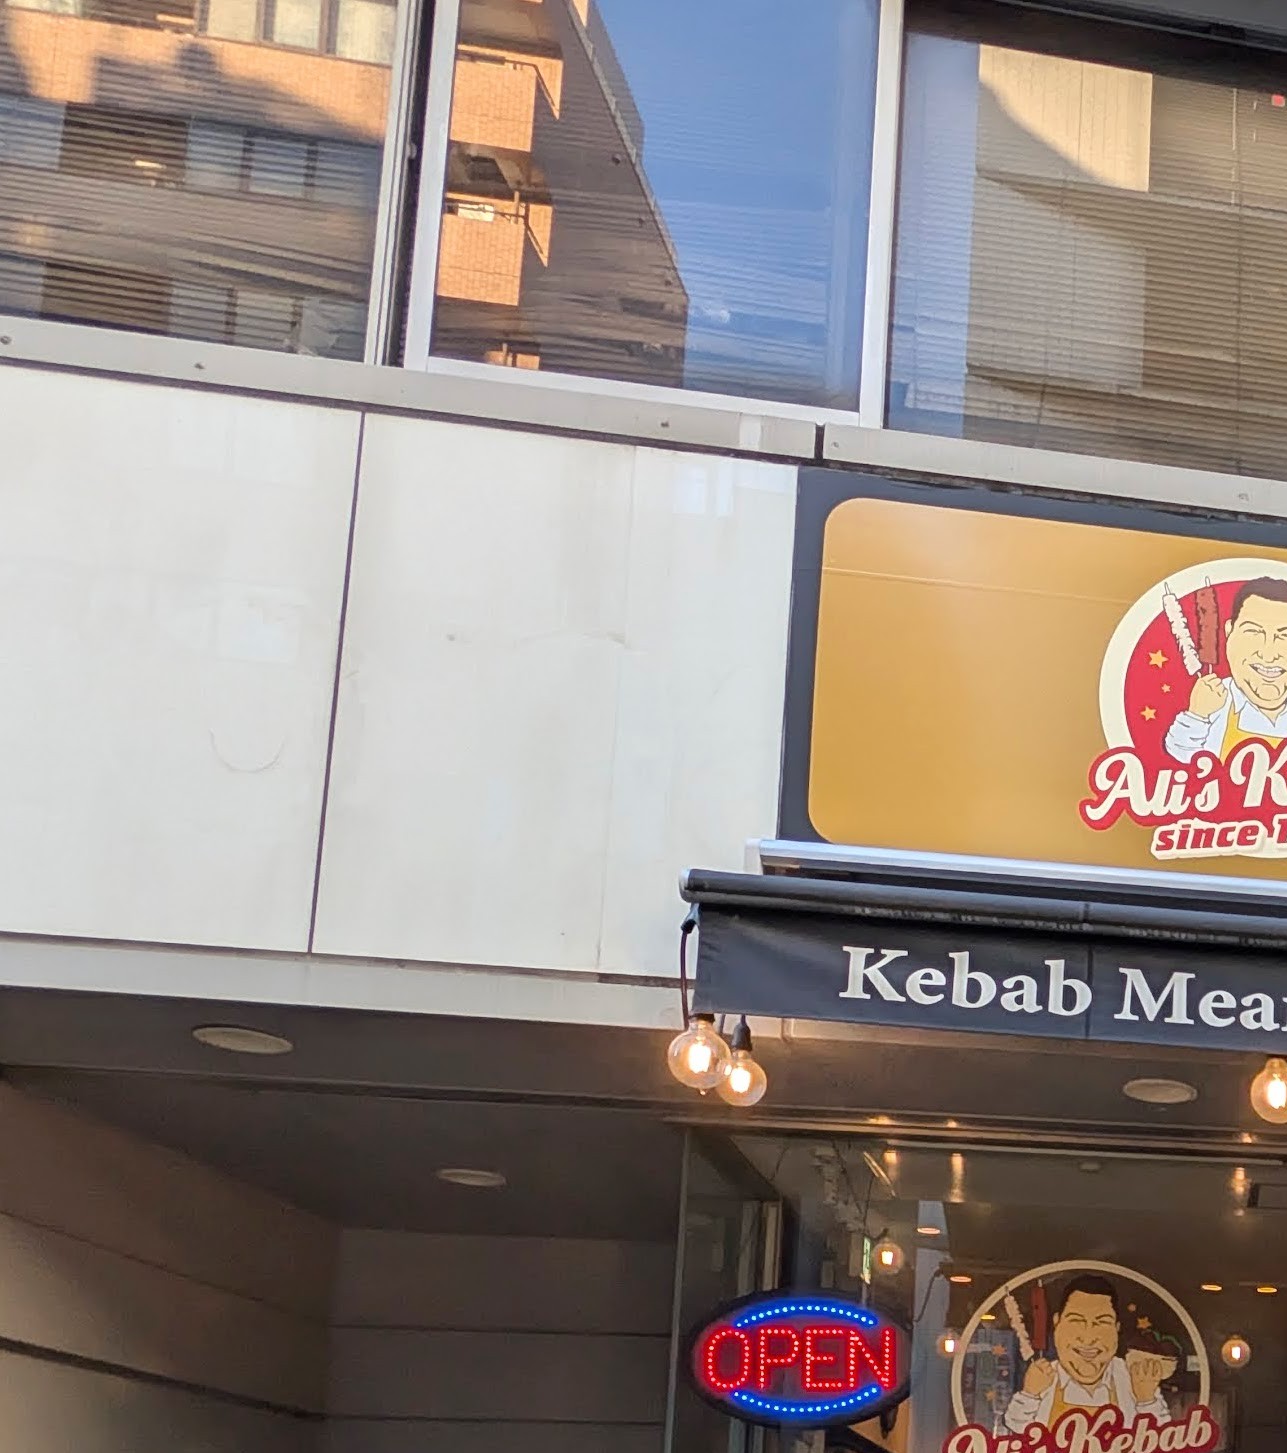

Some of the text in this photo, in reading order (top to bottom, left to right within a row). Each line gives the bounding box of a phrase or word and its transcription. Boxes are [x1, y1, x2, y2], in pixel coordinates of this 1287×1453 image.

[1156, 823, 1260, 852] since
[839, 945, 1092, 1016] Kebab
[704, 1327, 897, 1391] OPEN
